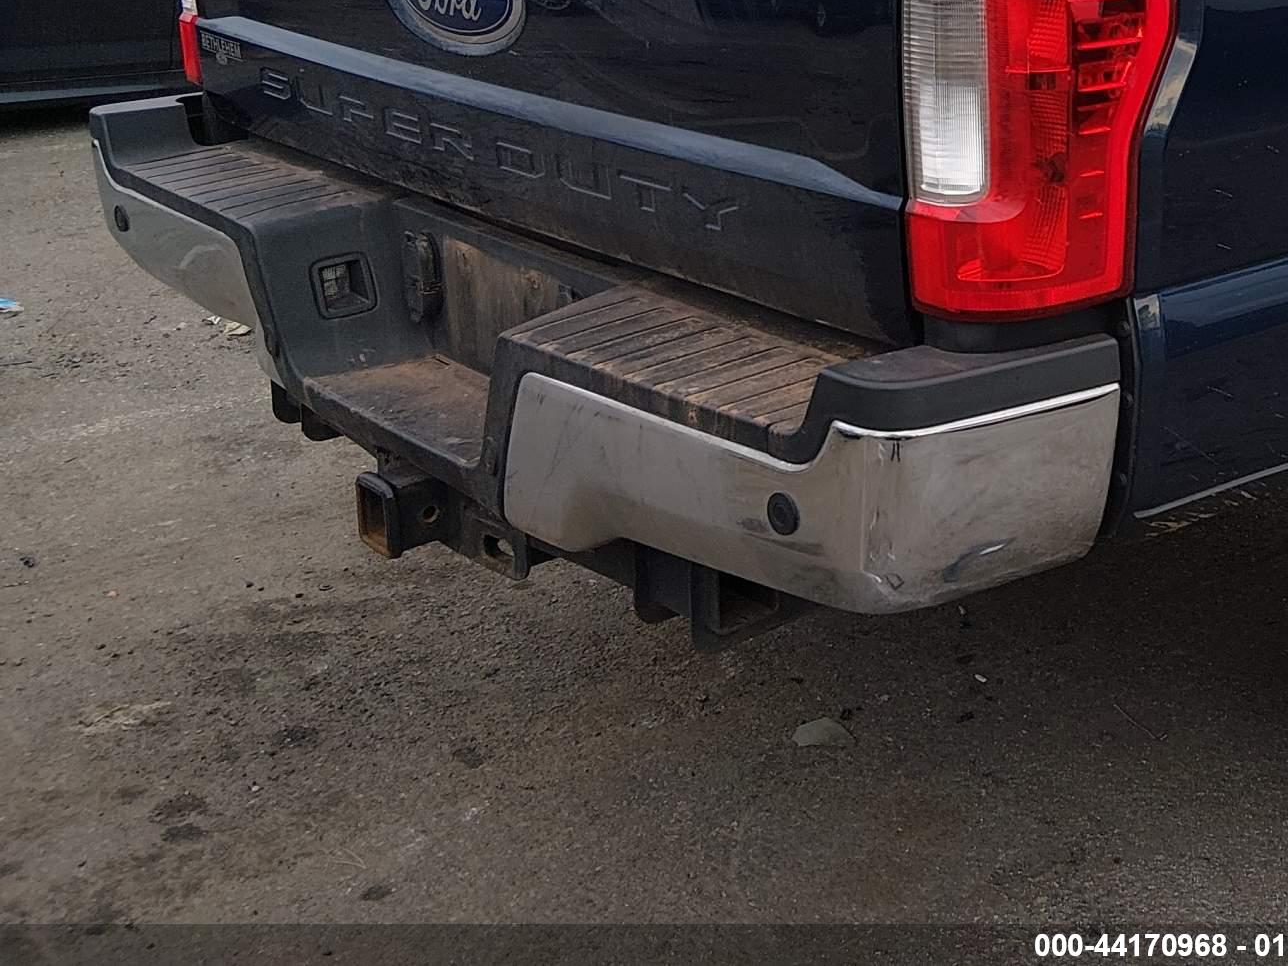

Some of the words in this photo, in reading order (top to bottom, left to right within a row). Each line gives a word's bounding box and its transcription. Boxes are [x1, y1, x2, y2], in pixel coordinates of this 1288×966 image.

[201, 32, 242, 59] BETHLEHEM
[259, 67, 474, 160] SUPER
[495, 141, 740, 232] DUTY
